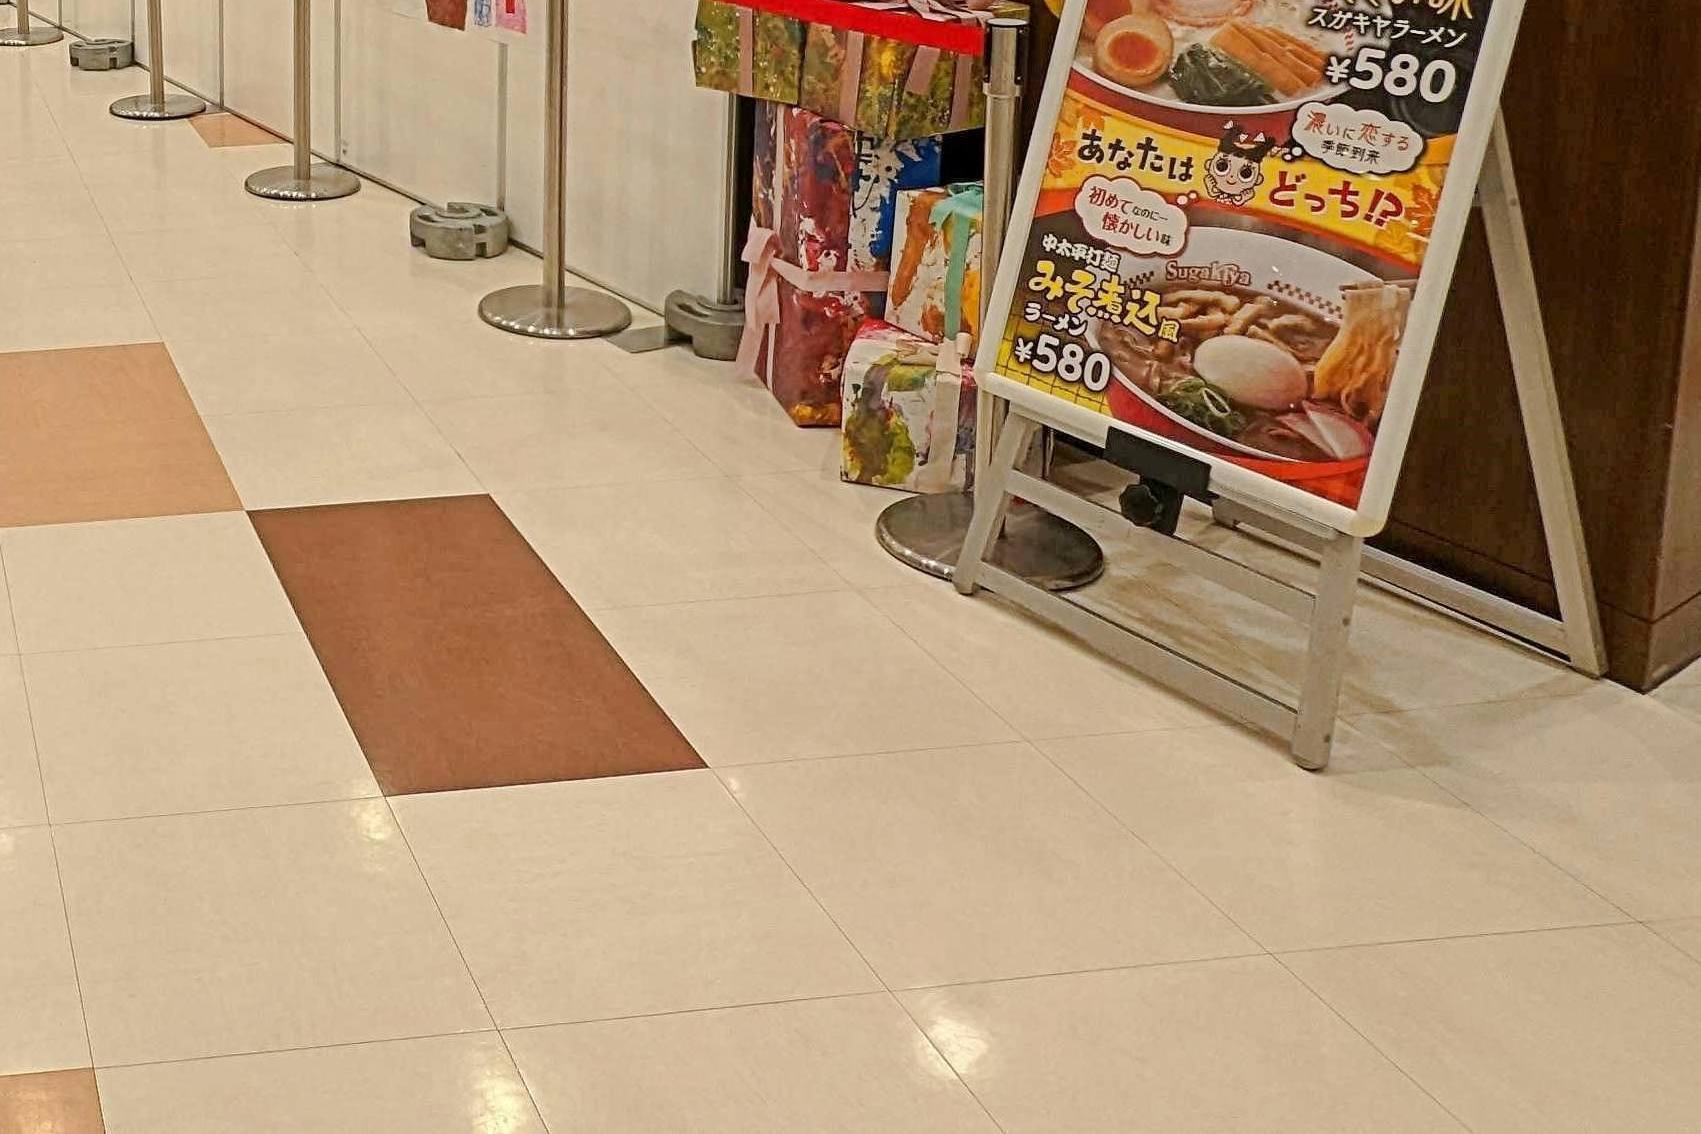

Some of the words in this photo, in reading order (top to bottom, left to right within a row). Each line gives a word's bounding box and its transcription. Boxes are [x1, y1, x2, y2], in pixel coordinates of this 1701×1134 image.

[1307, 7, 1467, 48] スガキヤラーメン
[1325, 47, 1456, 104] ¥580
[1304, 110, 1409, 152] 濃いに恋する
[1077, 129, 1194, 182] あなたは
[1321, 139, 1380, 165] 季節到来
[1102, 212, 1171, 247] 懐かしい味
[1165, 261, 1251, 287] Sugakiya
[1024, 301, 1088, 337] ラーメン
[1014, 334, 1111, 392] ¥580
